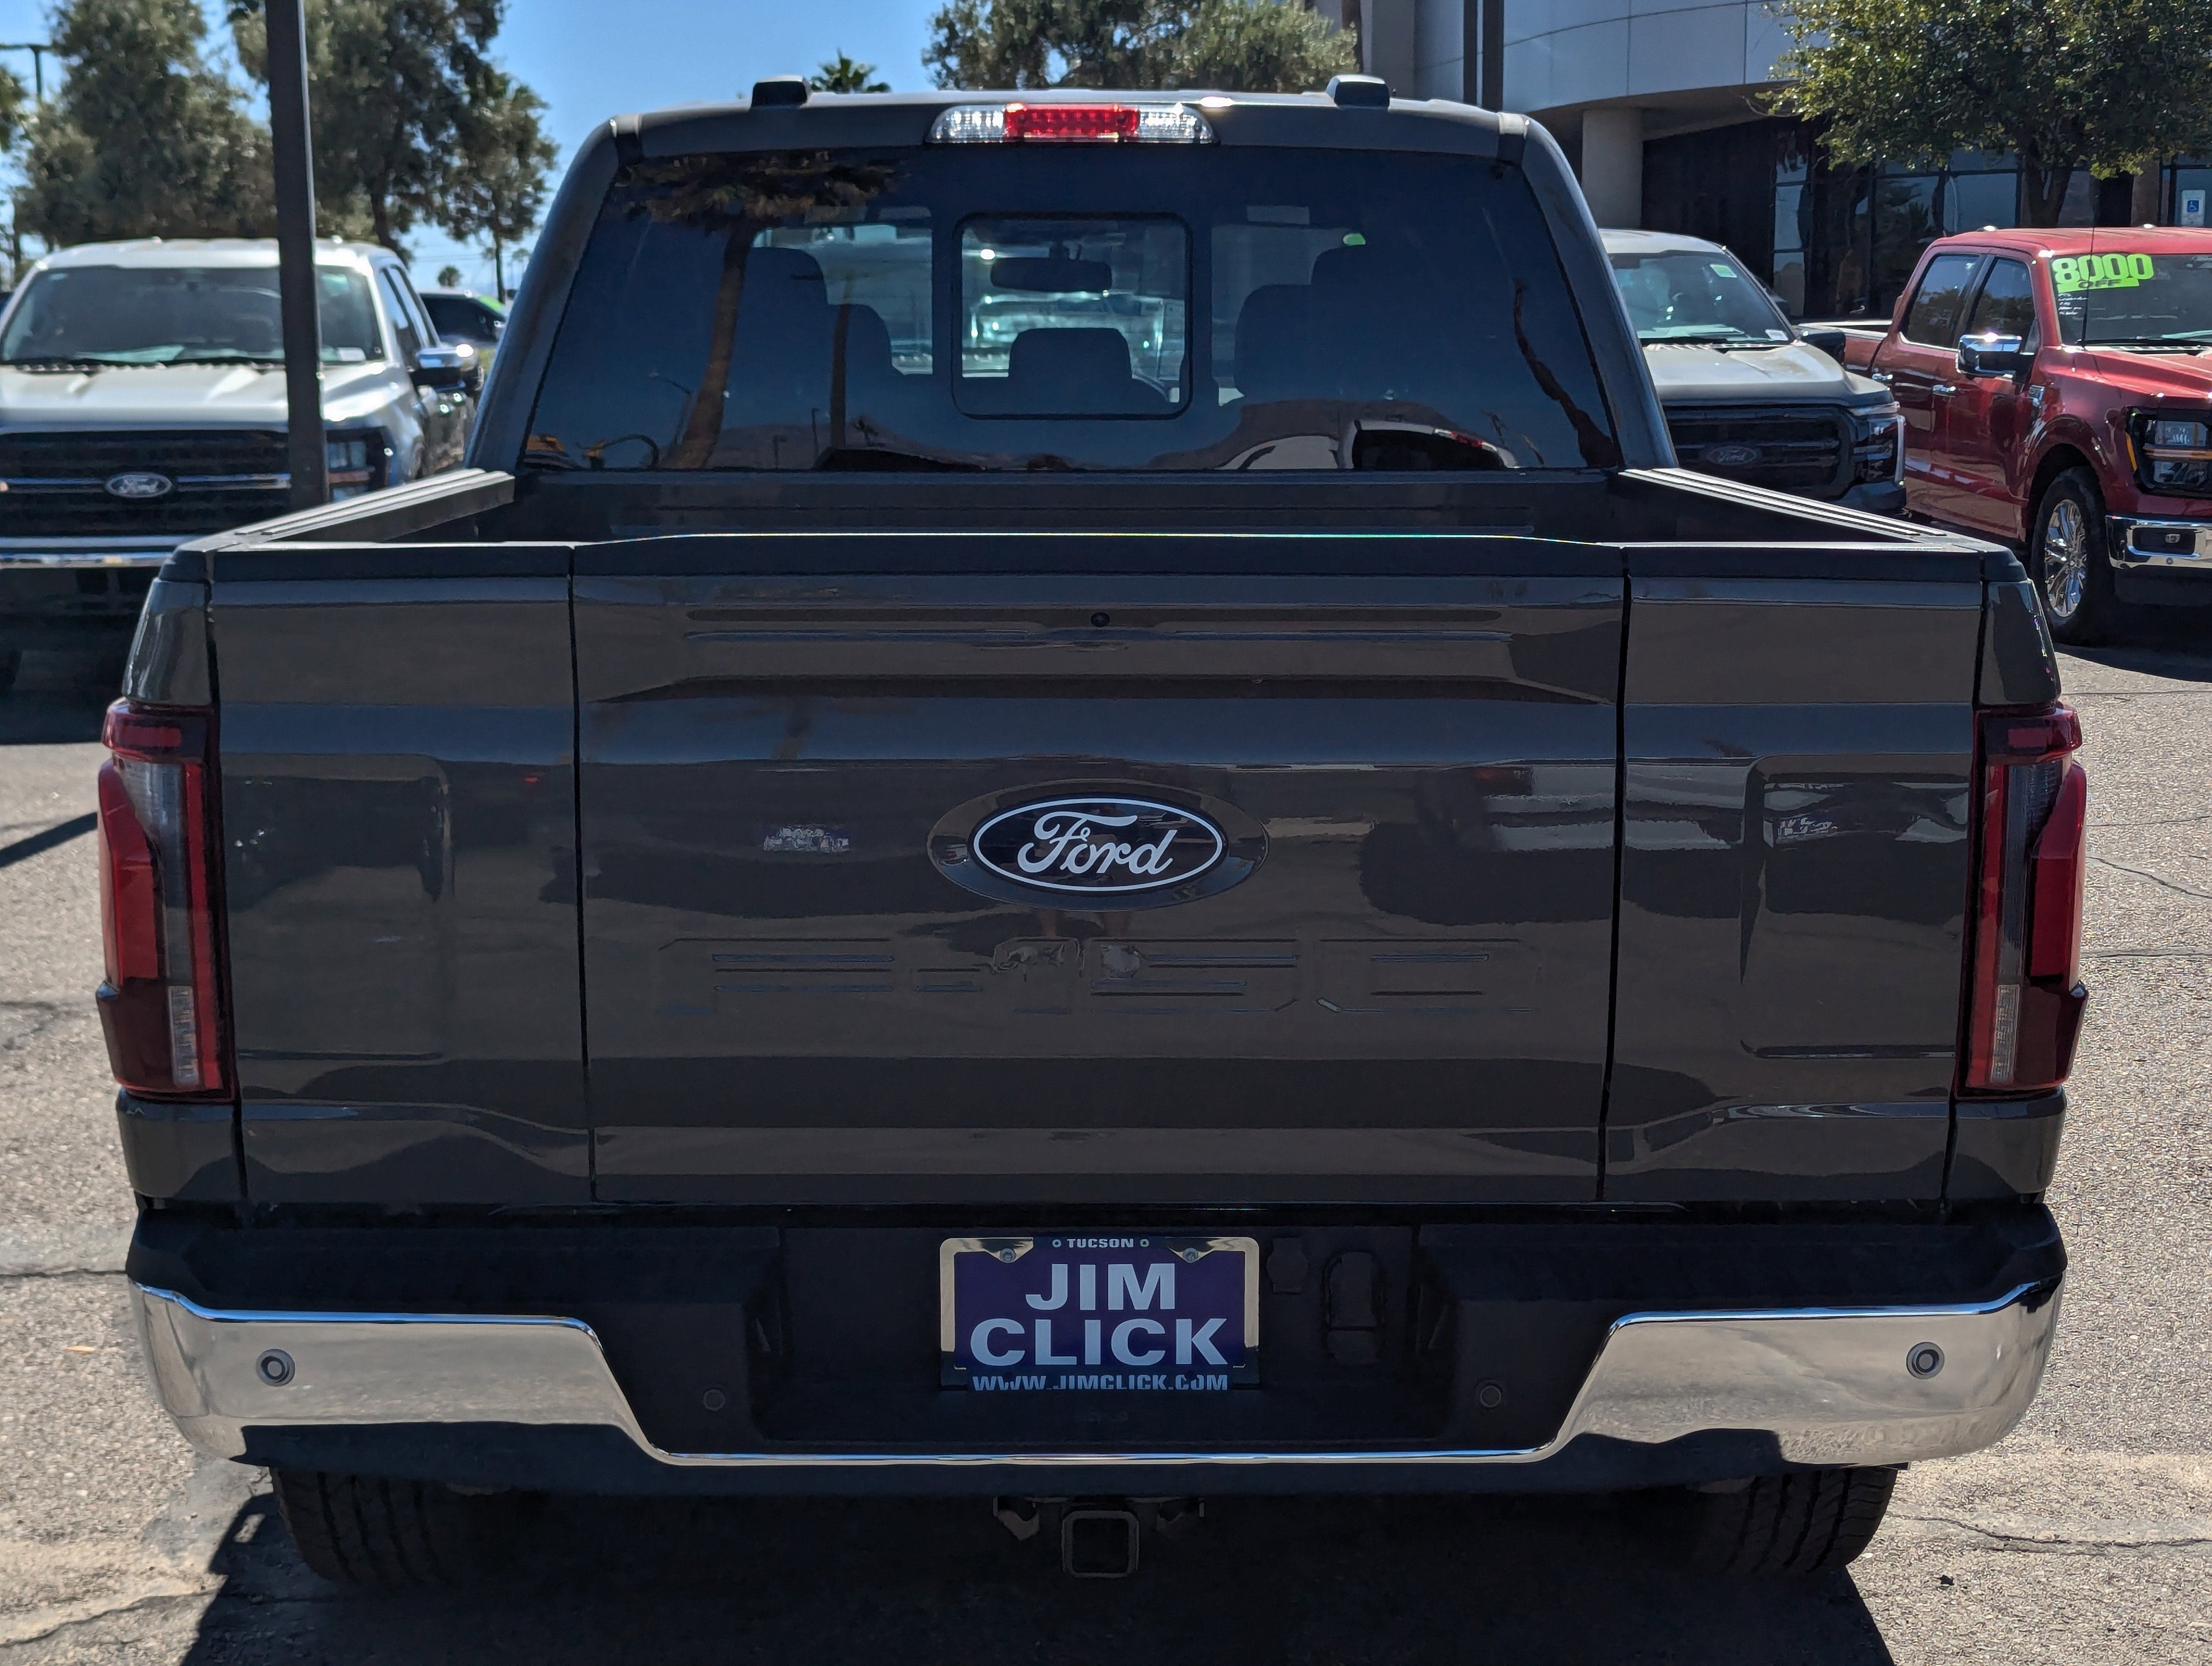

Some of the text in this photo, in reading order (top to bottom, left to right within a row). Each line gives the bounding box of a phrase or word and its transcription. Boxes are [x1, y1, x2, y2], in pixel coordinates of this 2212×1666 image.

[2052, 254, 2154, 284] 8000
[2079, 279, 2122, 289] OFF
[1017, 811, 1178, 874] Ford
[1066, 1238, 1134, 1248] TUCSON
[1026, 1263, 1175, 1311] JIM
[970, 1318, 1228, 1367] CLICK
